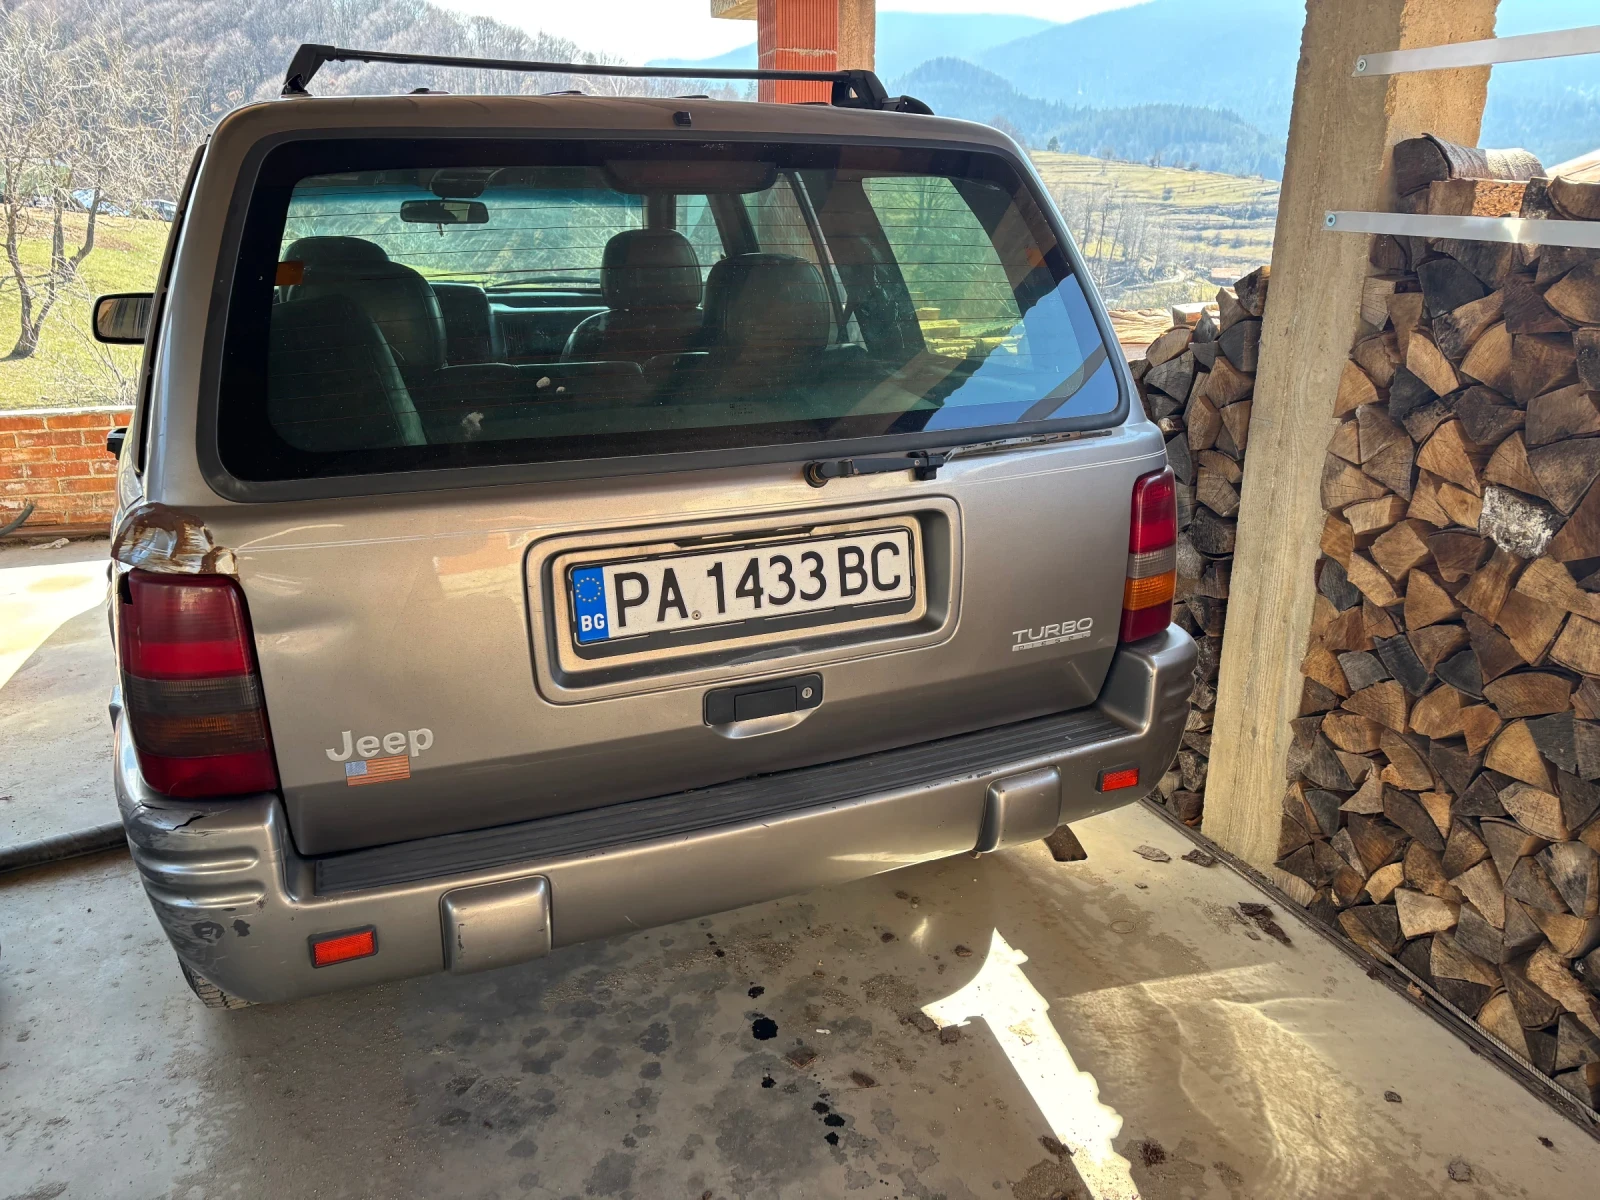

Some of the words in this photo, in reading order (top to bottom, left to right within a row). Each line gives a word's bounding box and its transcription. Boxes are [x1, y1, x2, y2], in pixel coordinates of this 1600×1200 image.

[614, 572, 688, 627] PA
[707, 551, 827, 613] 1433
[838, 542, 901, 596] BC
[581, 613, 605, 632] BG
[1012, 617, 1093, 643] TURBO
[325, 728, 434, 761] Jeep
